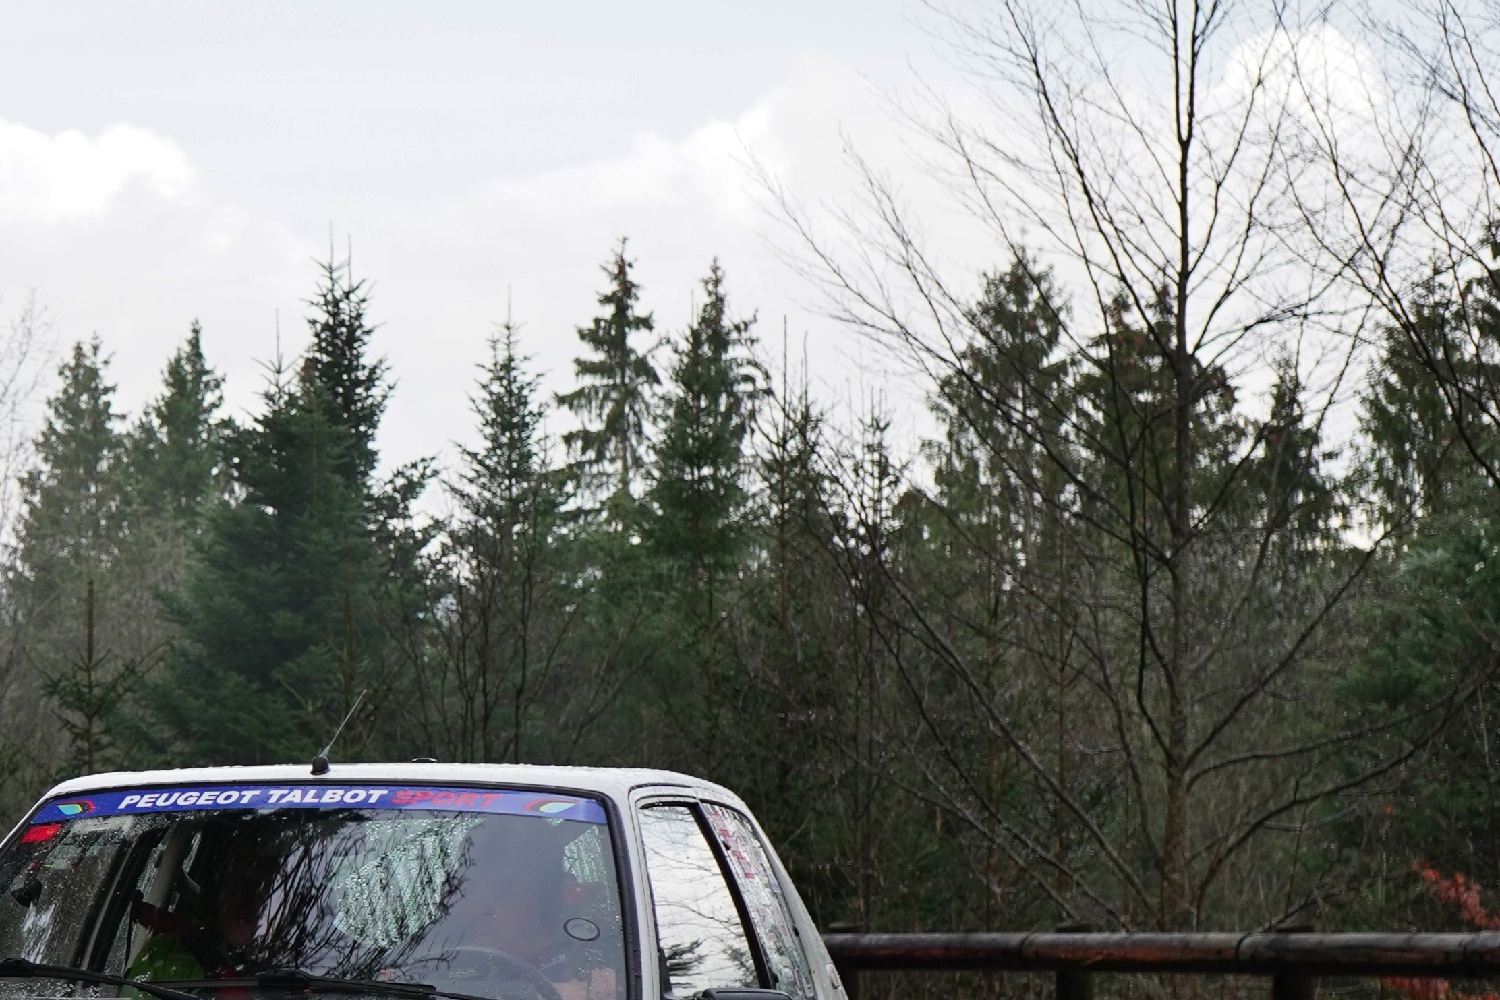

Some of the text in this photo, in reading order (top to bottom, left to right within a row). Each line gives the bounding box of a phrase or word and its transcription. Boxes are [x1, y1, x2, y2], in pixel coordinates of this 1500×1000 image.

[117, 789, 503, 809] PEUGEOT TALBOT SPORT
